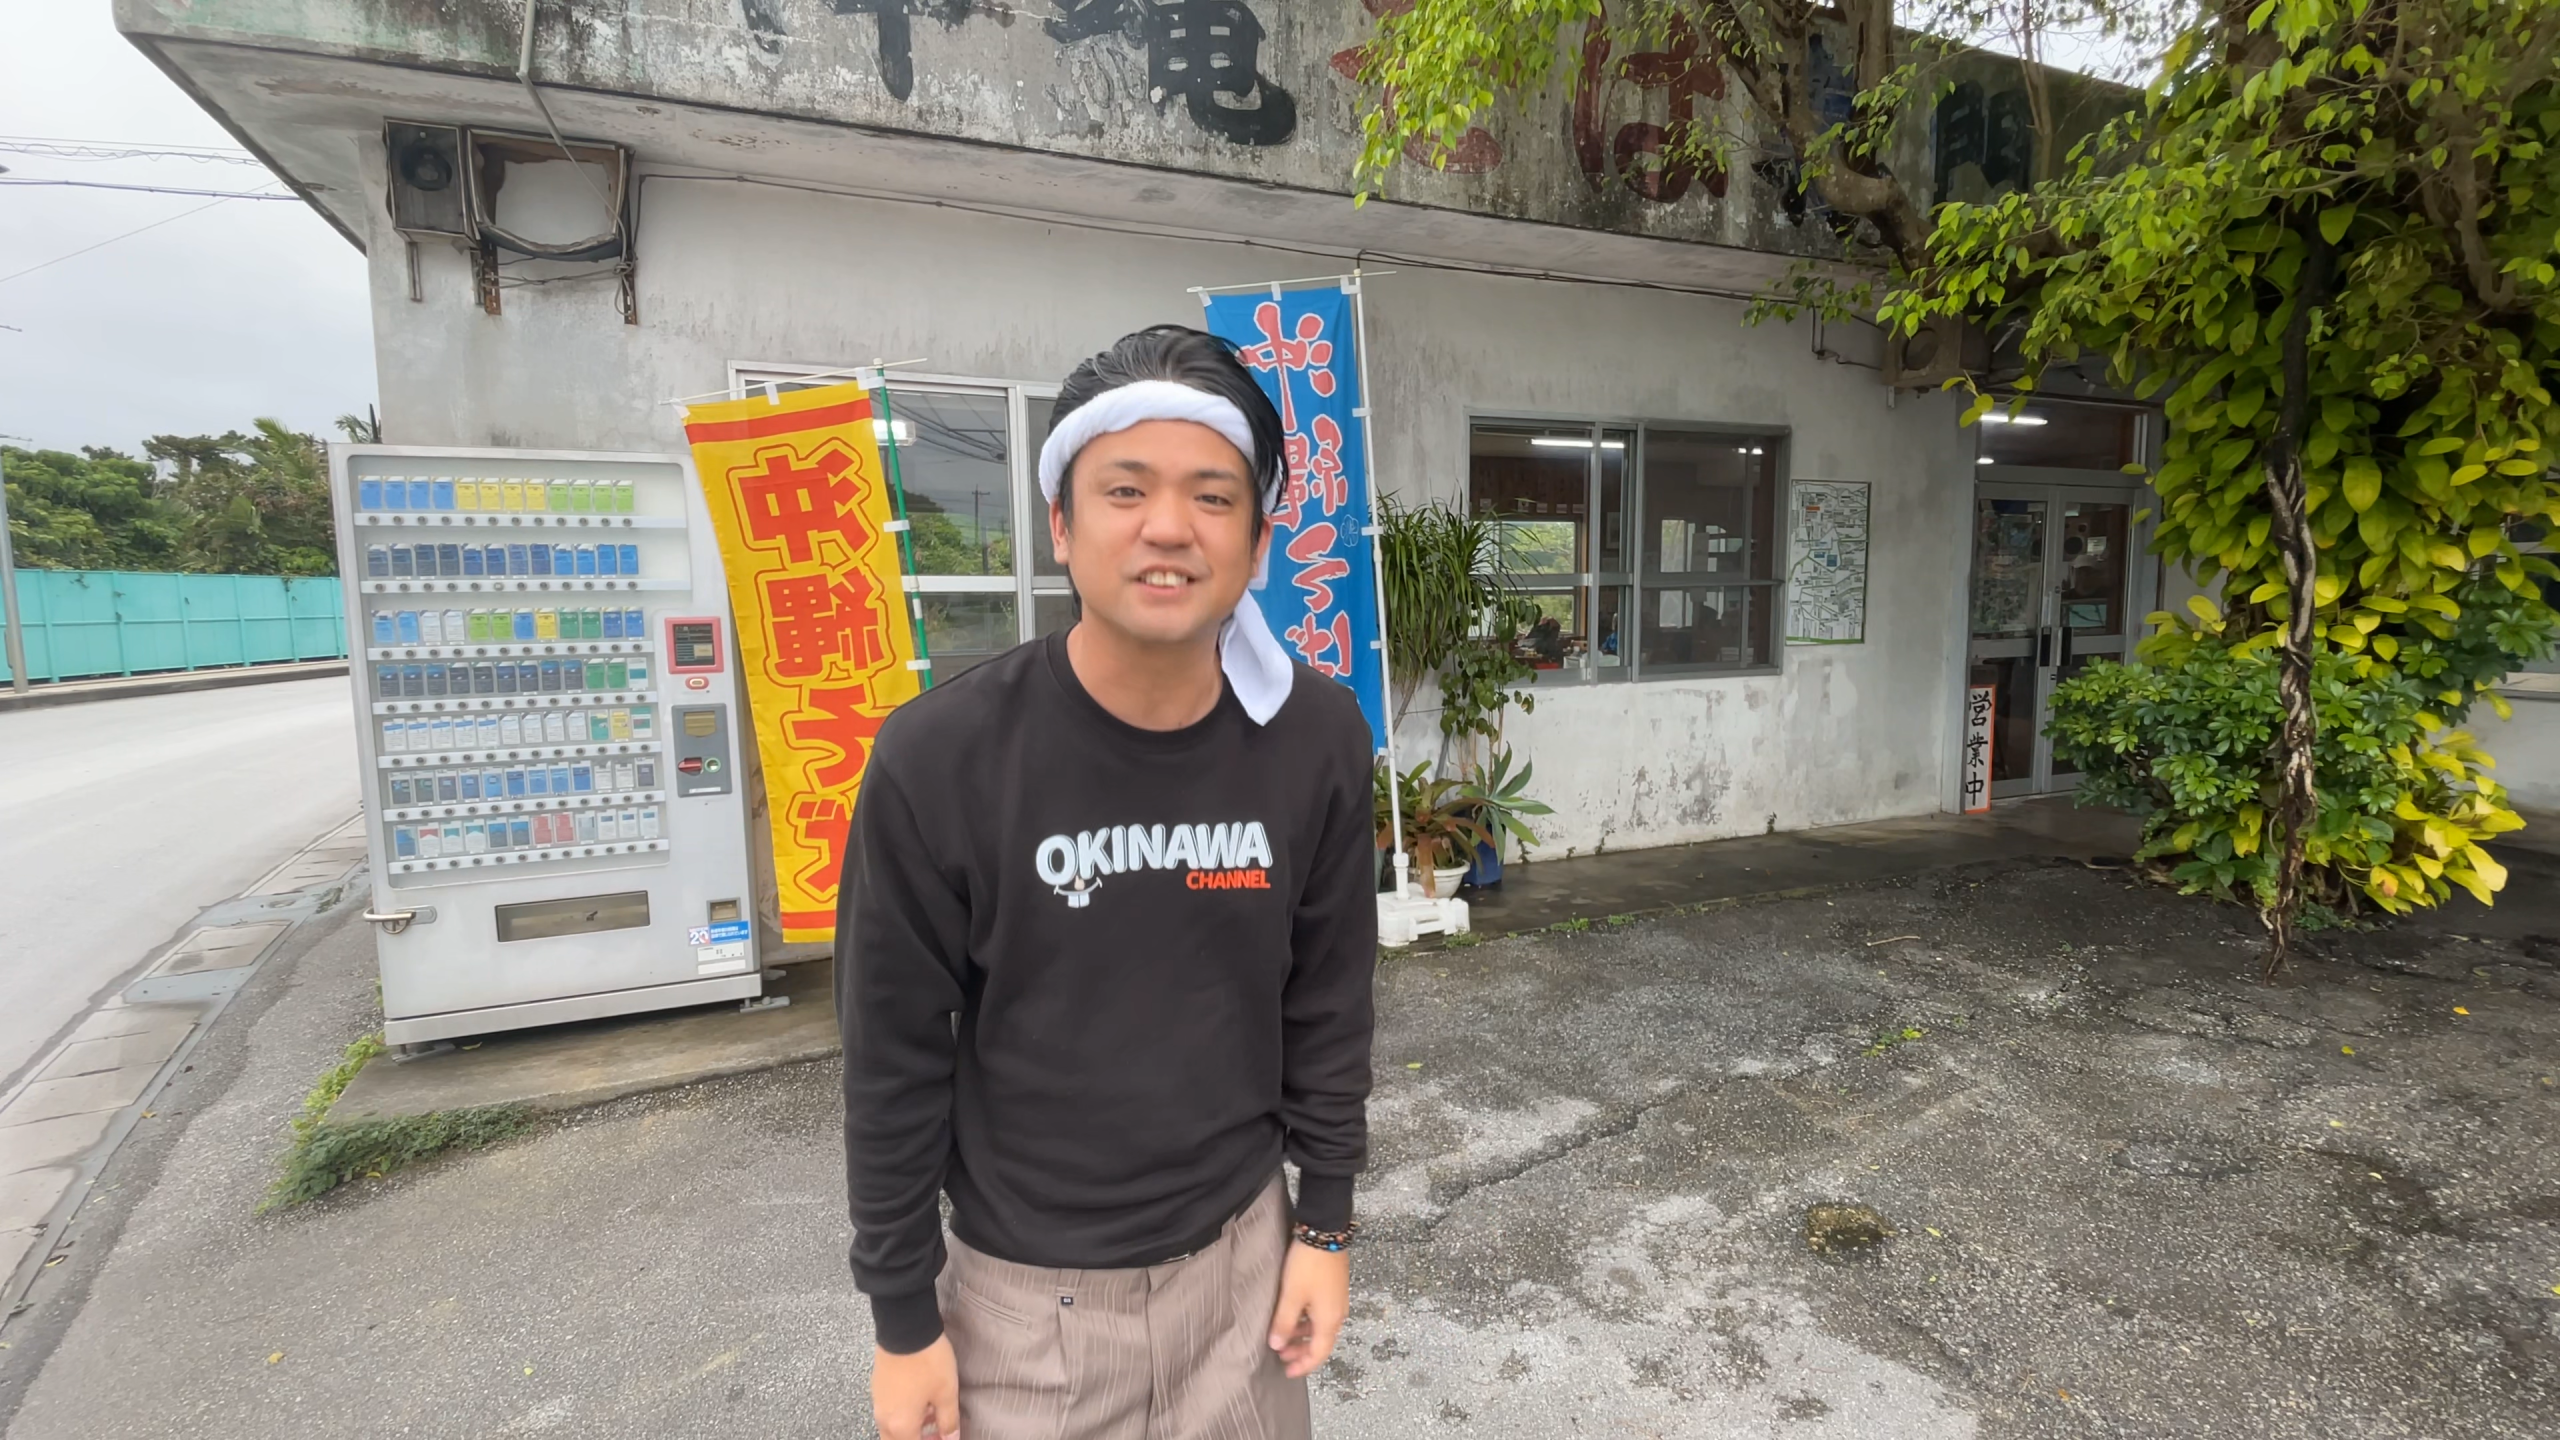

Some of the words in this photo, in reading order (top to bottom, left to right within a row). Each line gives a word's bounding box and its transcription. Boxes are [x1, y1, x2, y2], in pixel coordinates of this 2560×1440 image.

[1964, 690, 1993, 807] 営業中
[1035, 820, 1273, 886] OKINAWA
[1186, 869, 1271, 890] CHANNEL
